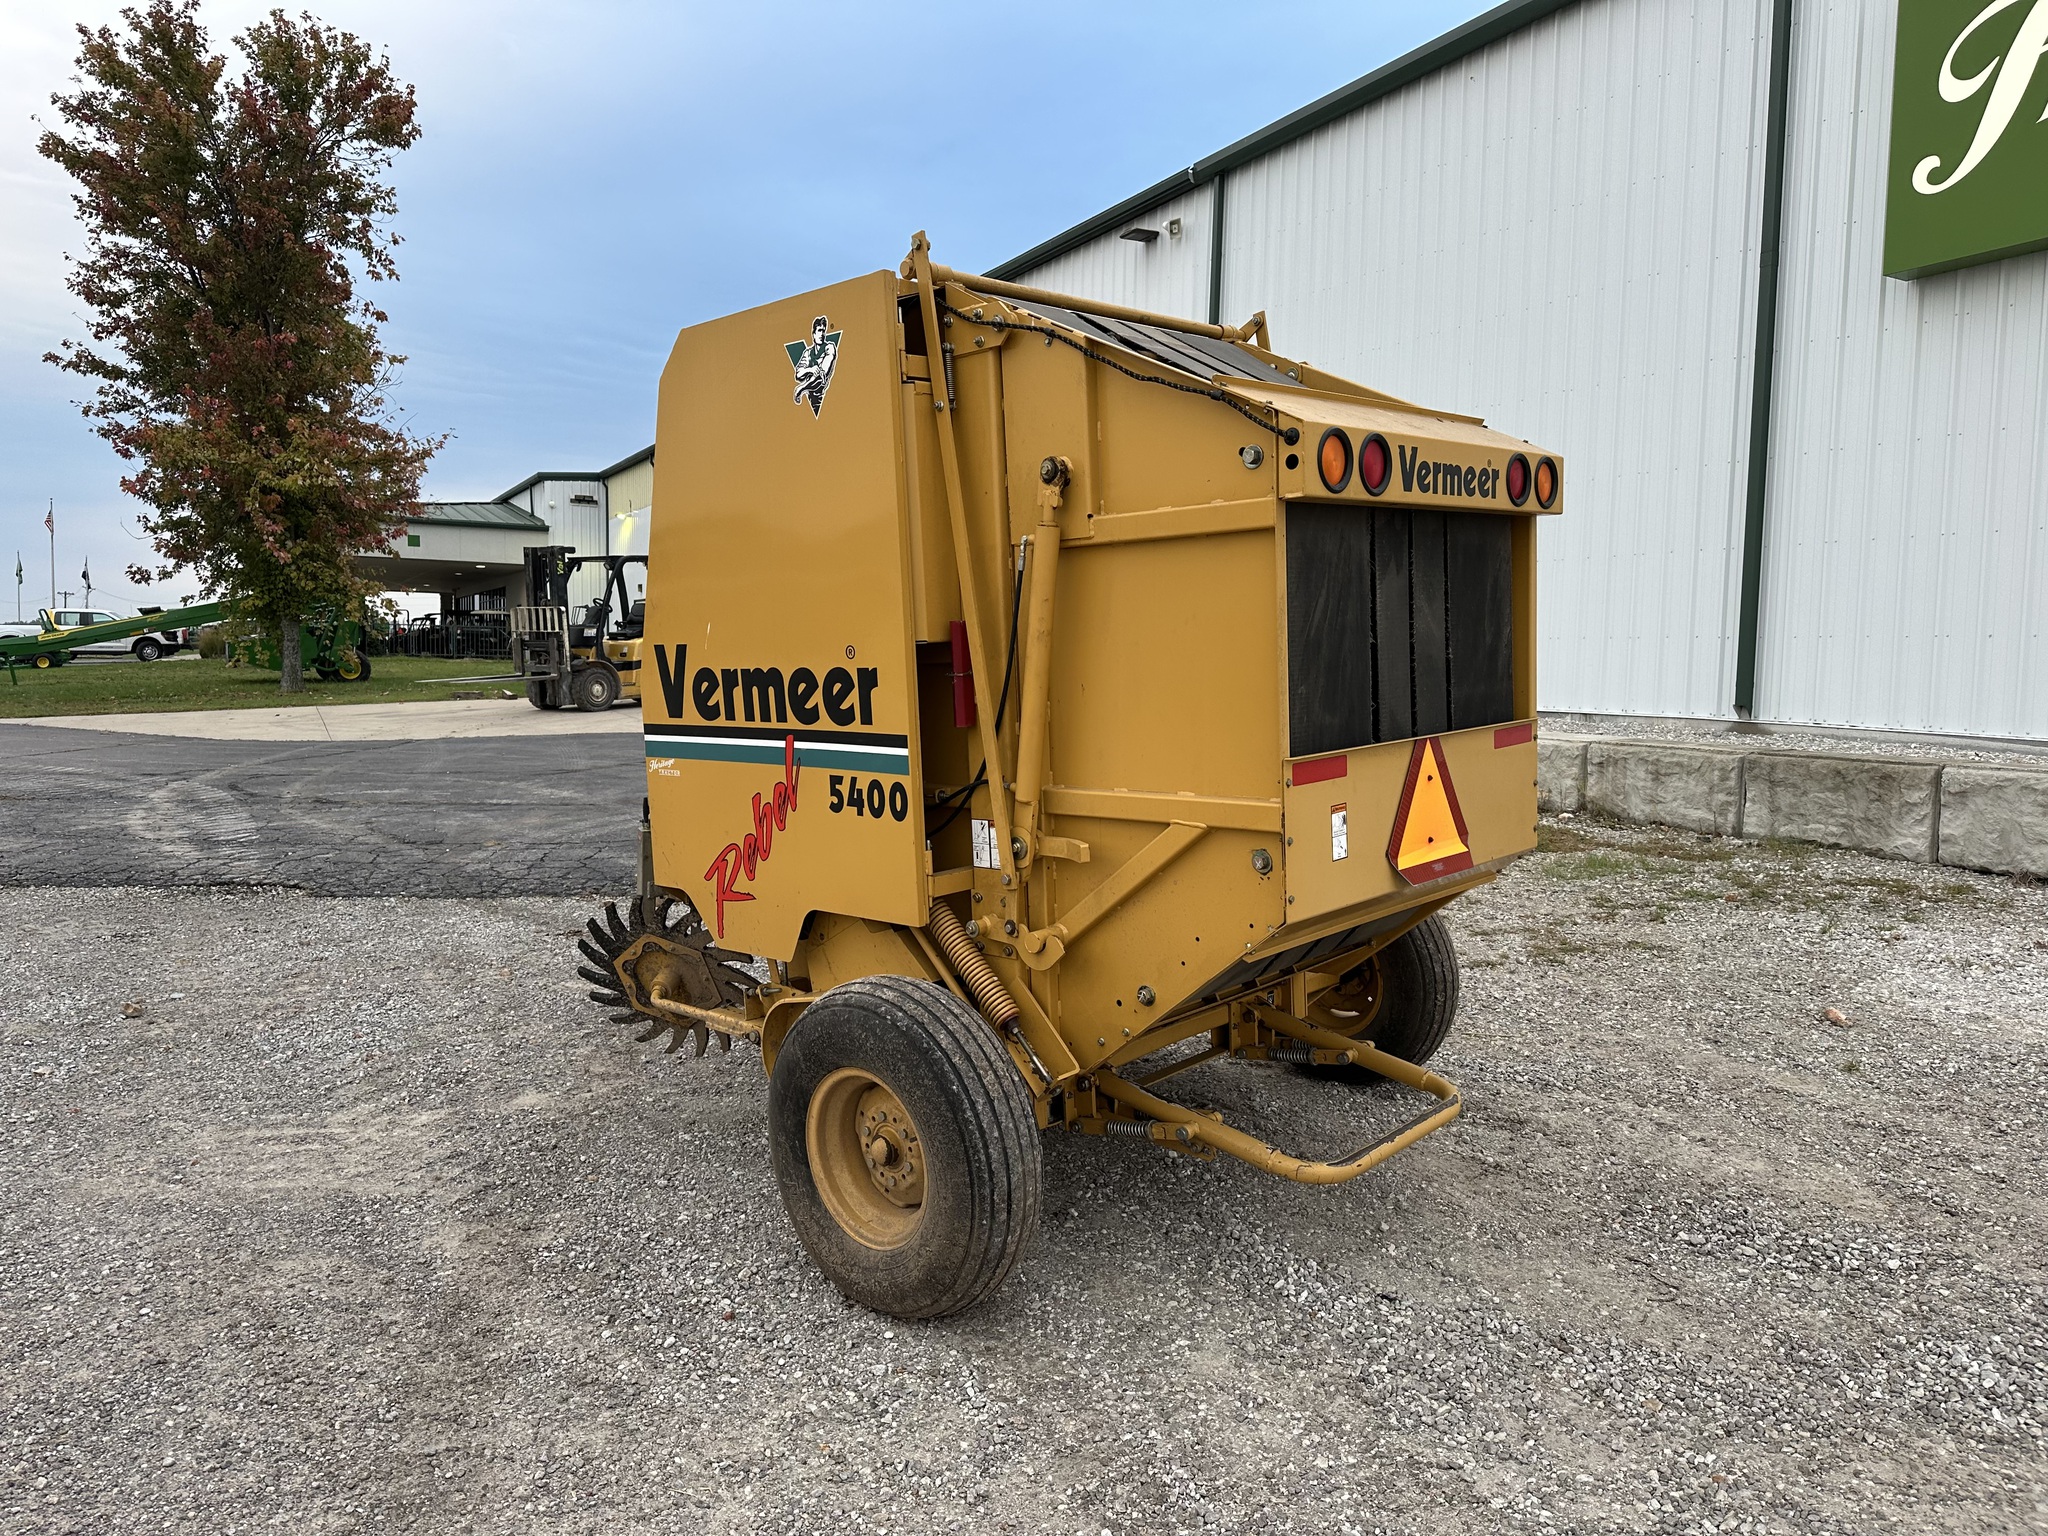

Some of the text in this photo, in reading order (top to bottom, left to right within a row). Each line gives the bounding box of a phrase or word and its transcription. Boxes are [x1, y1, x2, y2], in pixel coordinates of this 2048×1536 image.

[1398, 445, 1499, 499] Vermeer
[654, 644, 878, 726] Vermeer
[829, 774, 908, 822] 5400
[704, 734, 800, 939] Rebel
